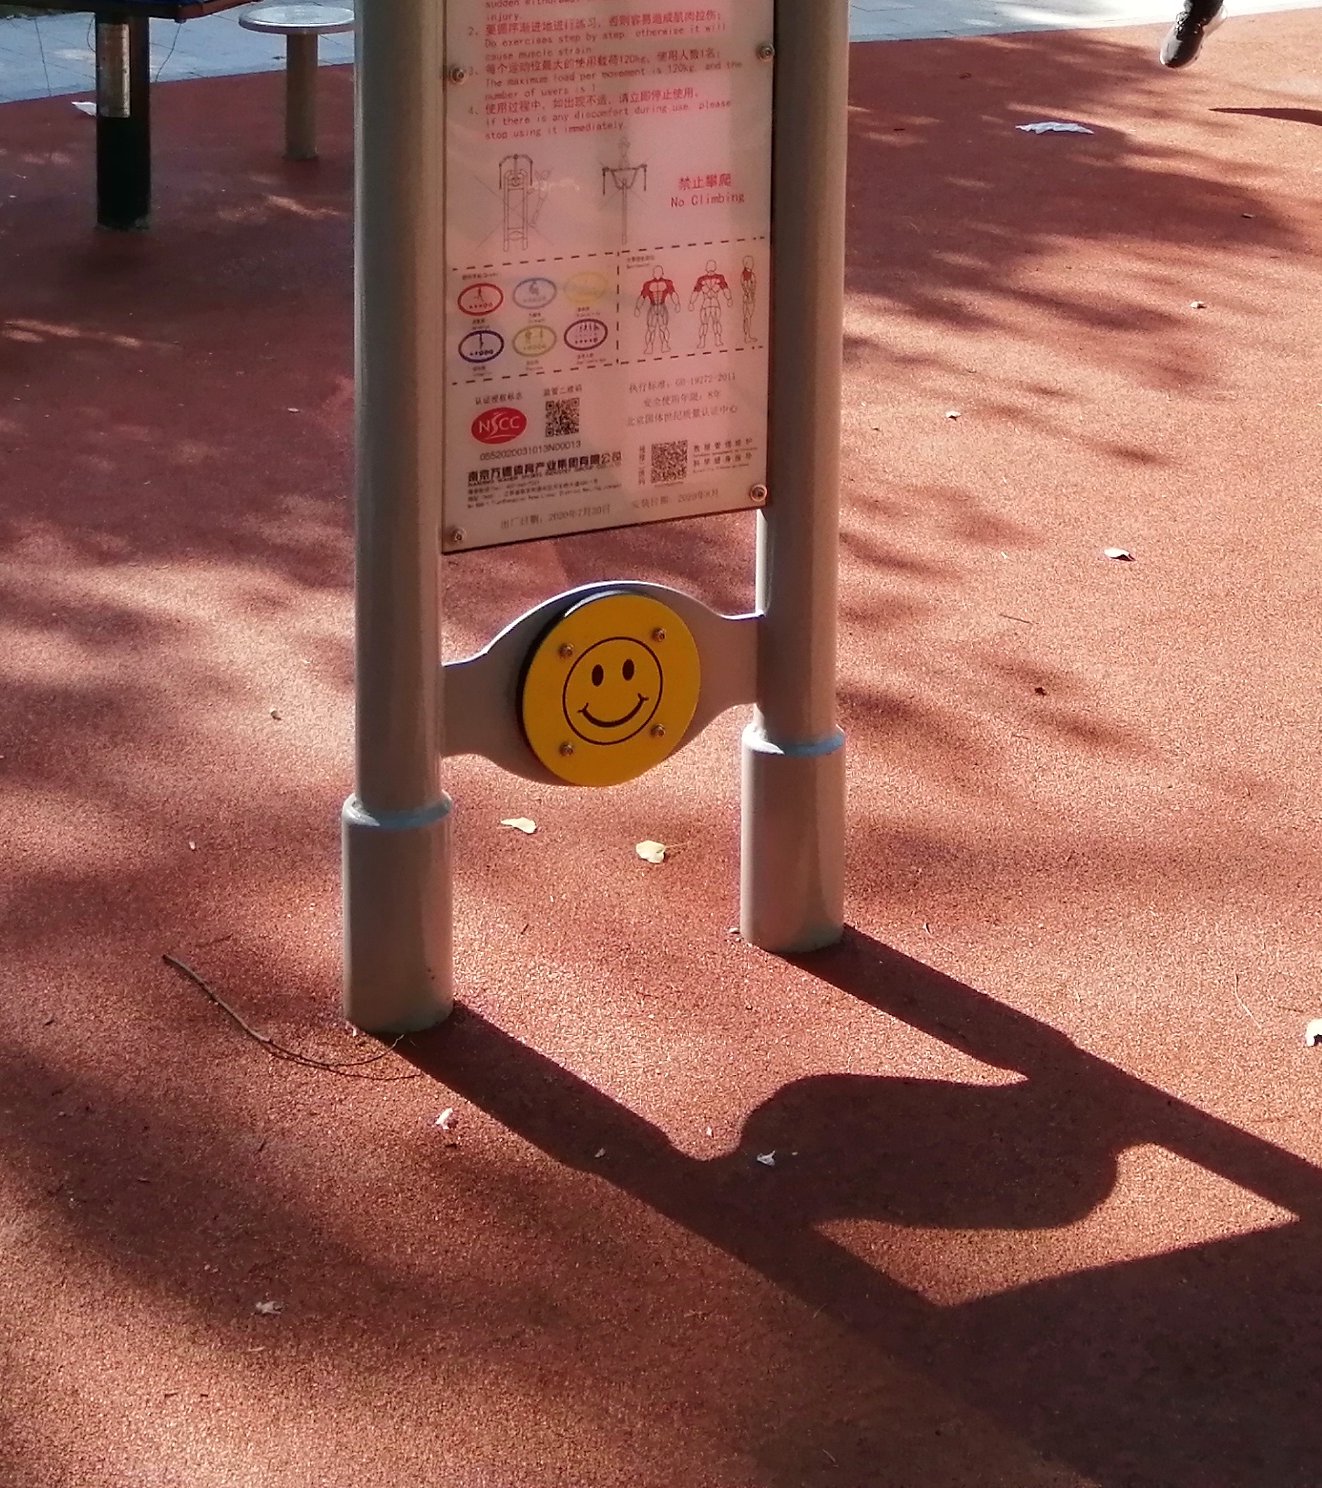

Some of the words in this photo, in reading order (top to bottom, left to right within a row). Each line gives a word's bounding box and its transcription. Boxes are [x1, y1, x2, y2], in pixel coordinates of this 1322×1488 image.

[485, 38, 497, 48] Do
[502, 36, 553, 47] exercises
[559, 34, 581, 45] step
[586, 32, 597, 42] by
[635, 26, 684, 38] otherwise
[691, 24, 700, 33] it
[705, 23, 726, 32] will
[485, 53, 513, 62] cause
[519, 48, 553, 59] muscle
[485, 78, 503, 88] The
[507, 76, 548, 86] maximum
[553, 72, 575, 82] load
[579, 72, 595, 82] per
[601, 68, 645, 80] movement
[705, 61, 721, 70] and
[727, 60, 743, 69] the
[485, 91, 519, 101] number
[524, 88, 535, 98] of
[541, 88, 569, 96] users
[486, 118, 497, 127] If
[503, 116, 531, 126] there
[537, 115, 547, 124] is
[553, 114, 569, 124] any
[574, 106, 629, 120] discomfort
[634, 104, 668, 116] during
[699, 100, 731, 111] please
[485, 131, 509, 141] stop
[513, 128, 542, 139] using
[548, 126, 557, 135] it
[679, 173, 732, 191] 禁止攀爬
[671, 196, 685, 208] No
[691, 192, 745, 206] Climbing
[479, 412, 522, 436] NSCC
[468, 451, 622, 482] 南京万德体育产业集团有限公司
